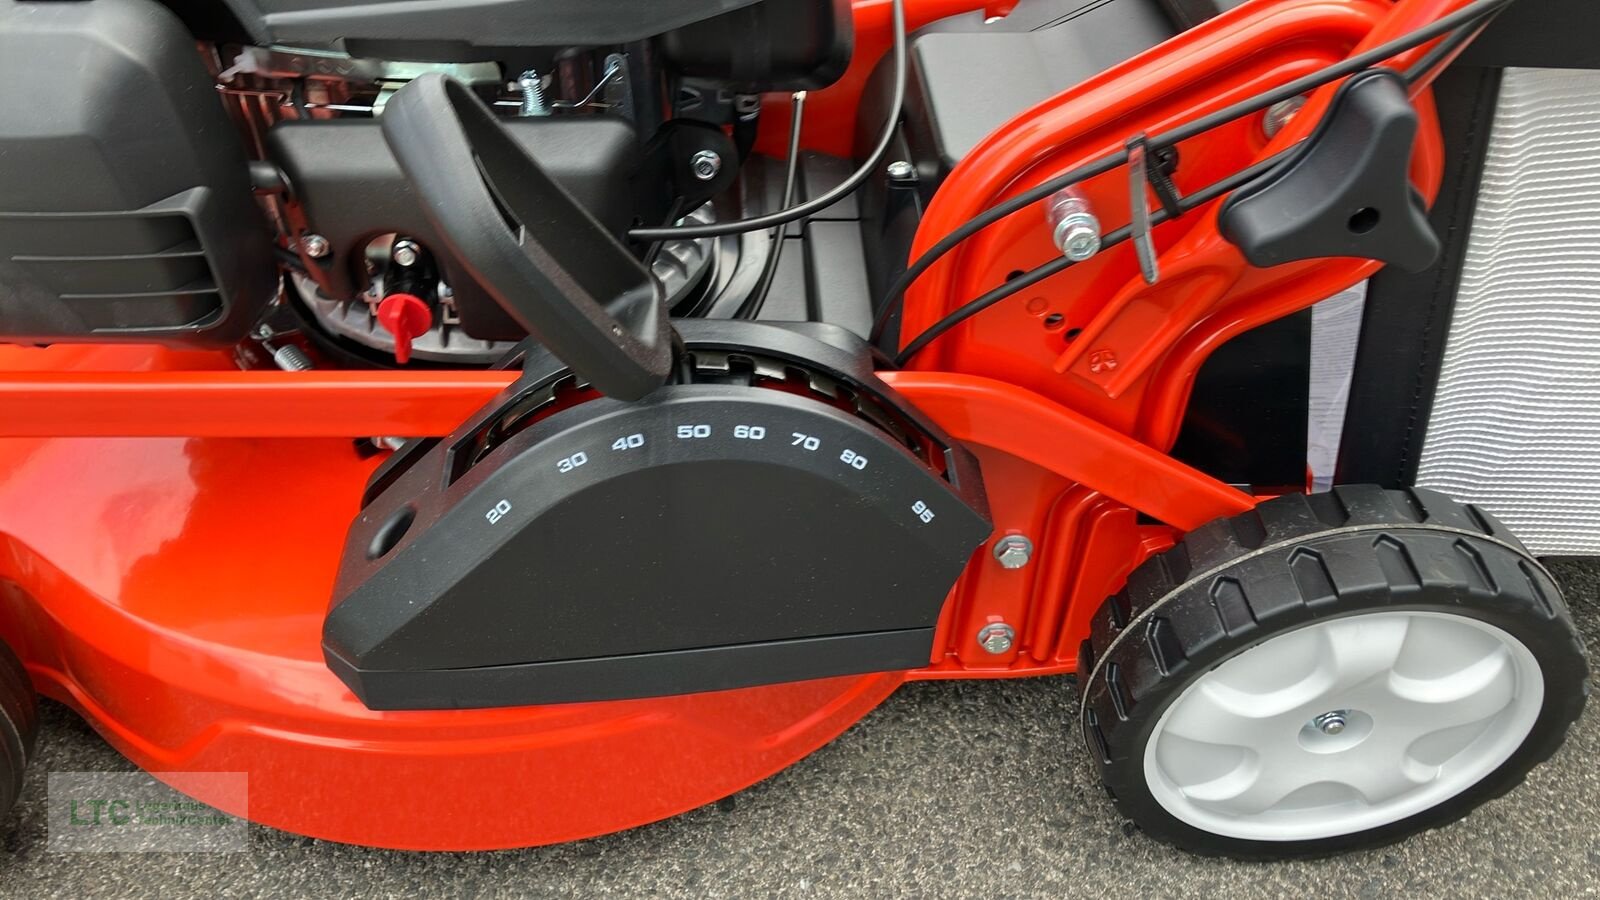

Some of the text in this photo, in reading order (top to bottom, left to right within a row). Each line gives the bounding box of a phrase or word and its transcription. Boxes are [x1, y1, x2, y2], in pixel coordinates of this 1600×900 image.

[677, 424, 712, 440] 50
[733, 424, 766, 440] 60
[791, 432, 821, 451] 70
[611, 433, 645, 452] 40
[556, 451, 589, 474] 30
[839, 448, 868, 470] 80
[485, 499, 513, 525] 20
[911, 501, 935, 524] 95
